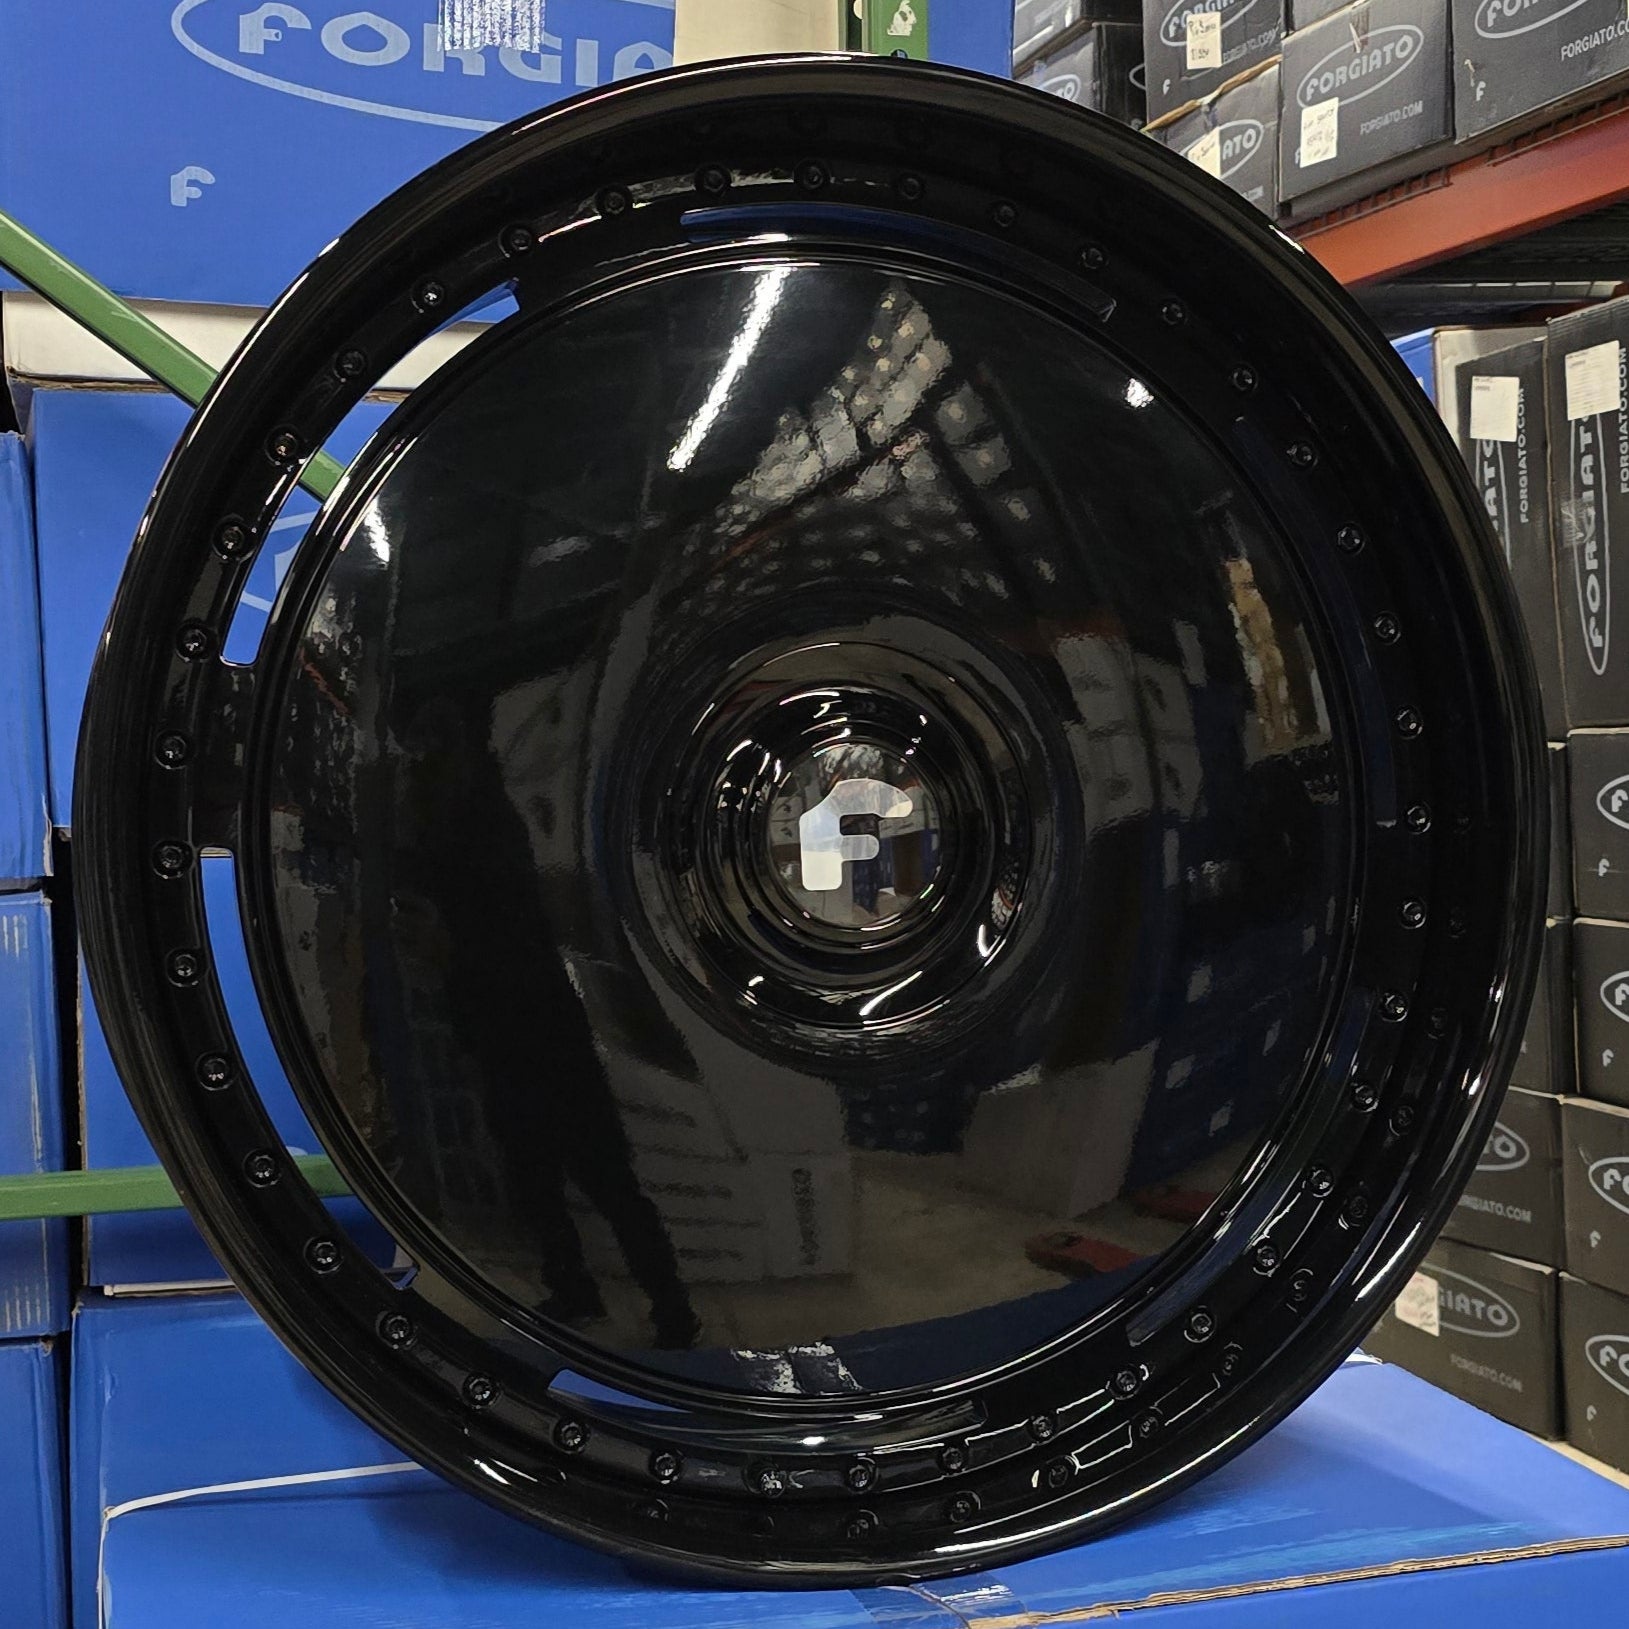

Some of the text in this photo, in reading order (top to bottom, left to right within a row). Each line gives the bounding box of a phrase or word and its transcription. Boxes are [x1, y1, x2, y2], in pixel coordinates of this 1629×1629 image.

[1306, 34, 1413, 101] FORGIATO
[1476, 81, 1486, 101] F
[1360, 100, 1423, 135] FORGIATO.COM
[1222, 128, 1256, 160] ATO
[171, 166, 216, 207] F
[1599, 858, 1610, 877] F
[1602, 1049, 1614, 1067] F
[1590, 1230, 1601, 1248] F
[1586, 1404, 1597, 1421] F
